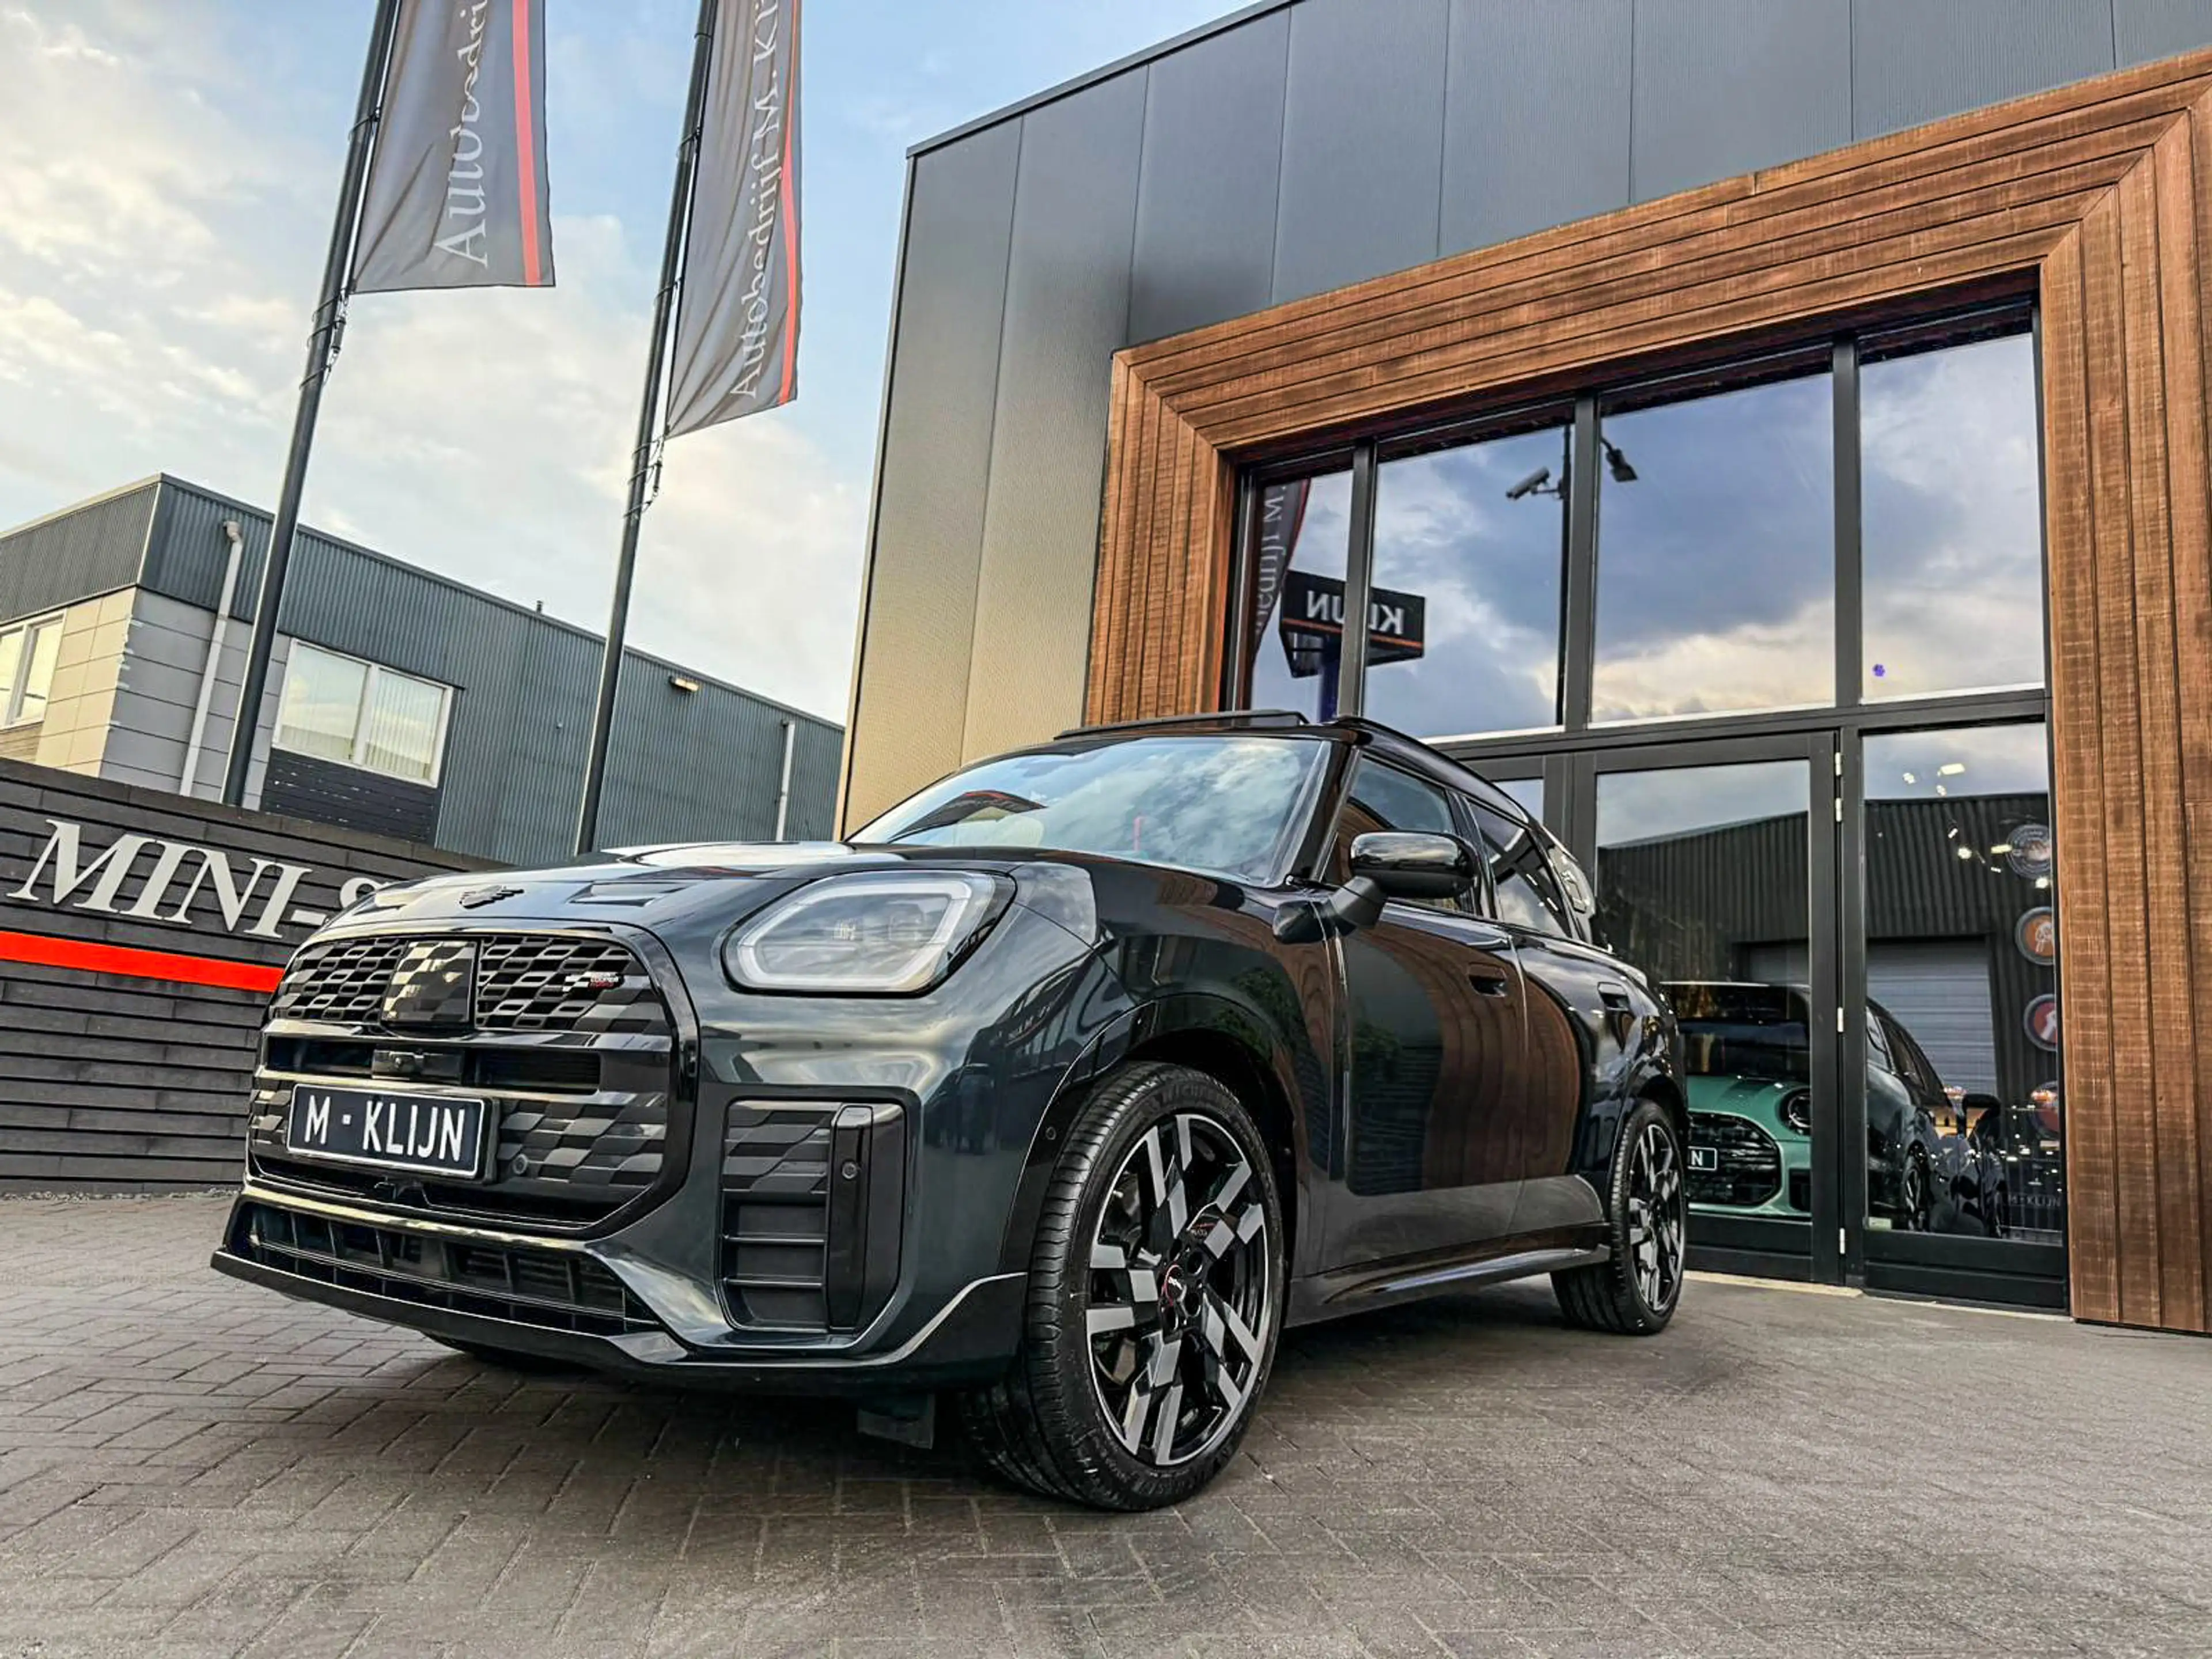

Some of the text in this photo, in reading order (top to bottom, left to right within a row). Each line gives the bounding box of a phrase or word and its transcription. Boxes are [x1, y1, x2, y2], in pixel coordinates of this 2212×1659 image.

[730, 0, 782, 399] Autobedrijf M. Kl
[304, 1094, 331, 1145] M
[362, 1100, 465, 1162] KLIJN
